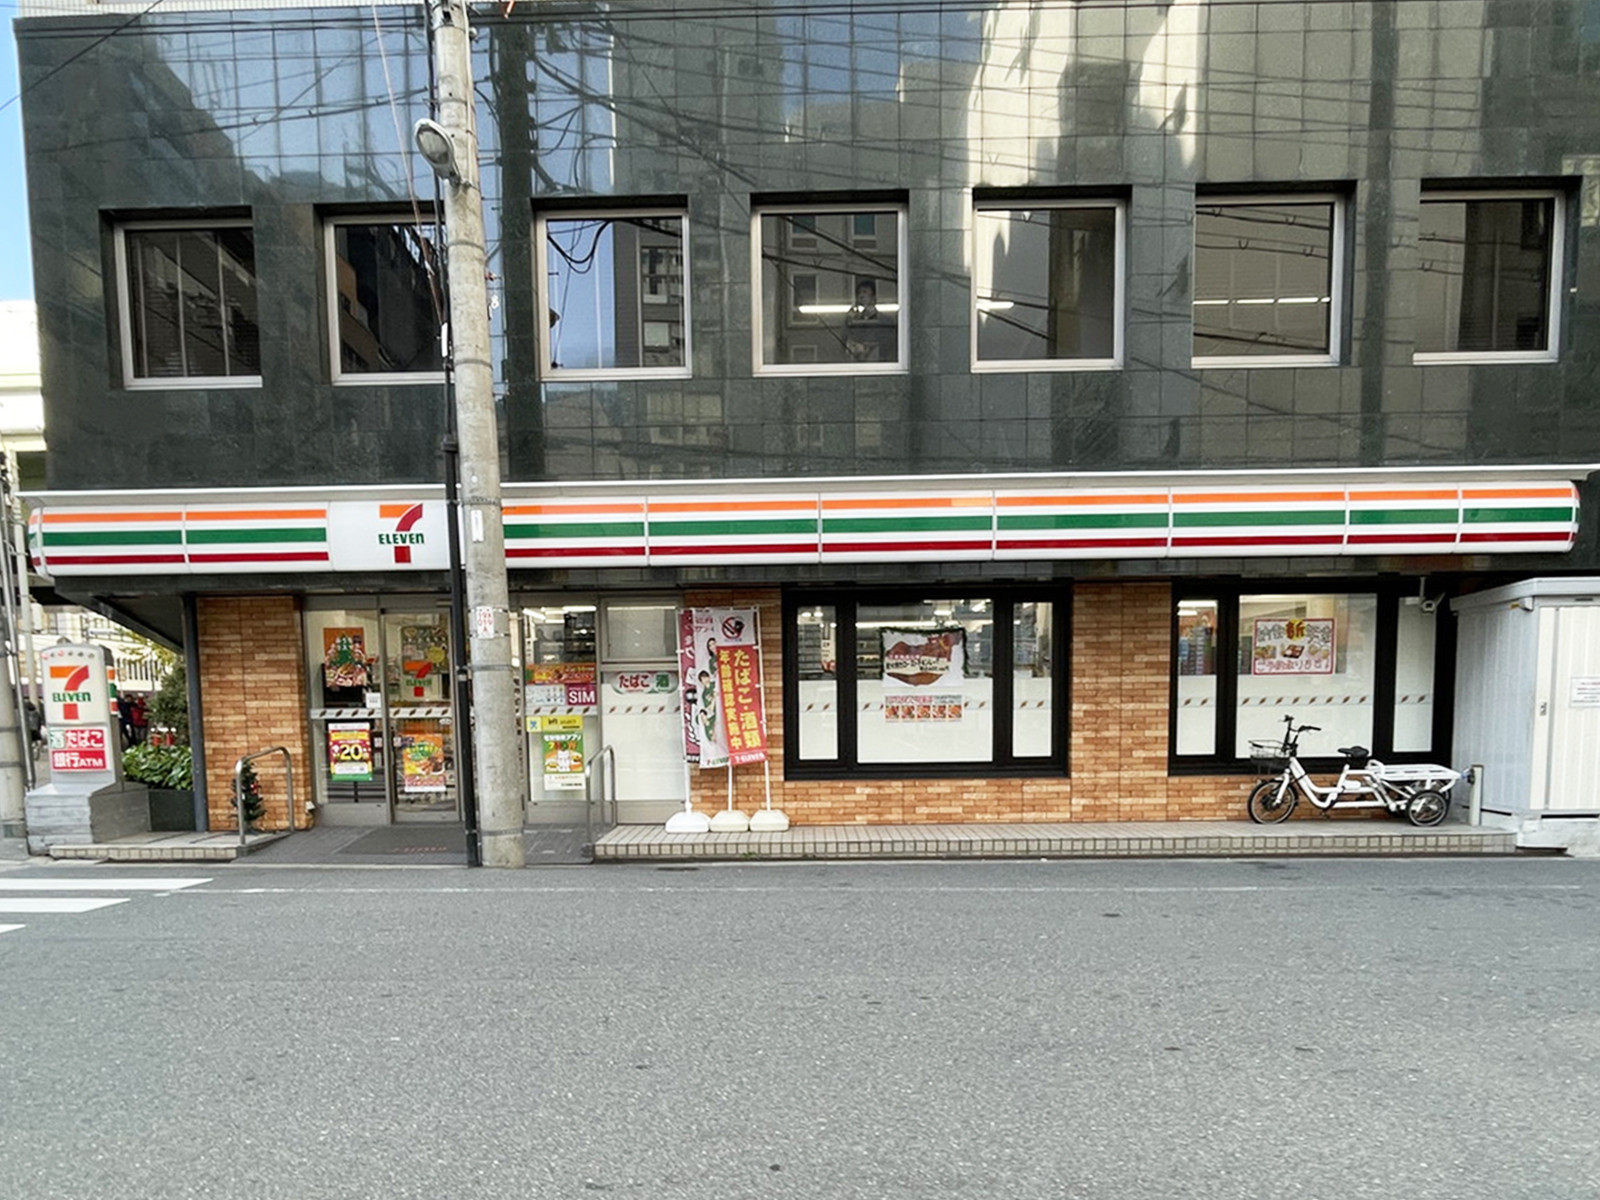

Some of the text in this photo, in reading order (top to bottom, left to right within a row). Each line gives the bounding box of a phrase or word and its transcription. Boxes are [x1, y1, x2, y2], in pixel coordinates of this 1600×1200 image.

[618, 674, 670, 688] たばこ 酒
[568, 690, 596, 704] SIM
[66, 730, 103, 748] たばこ
[340, 744, 362, 760] 20
